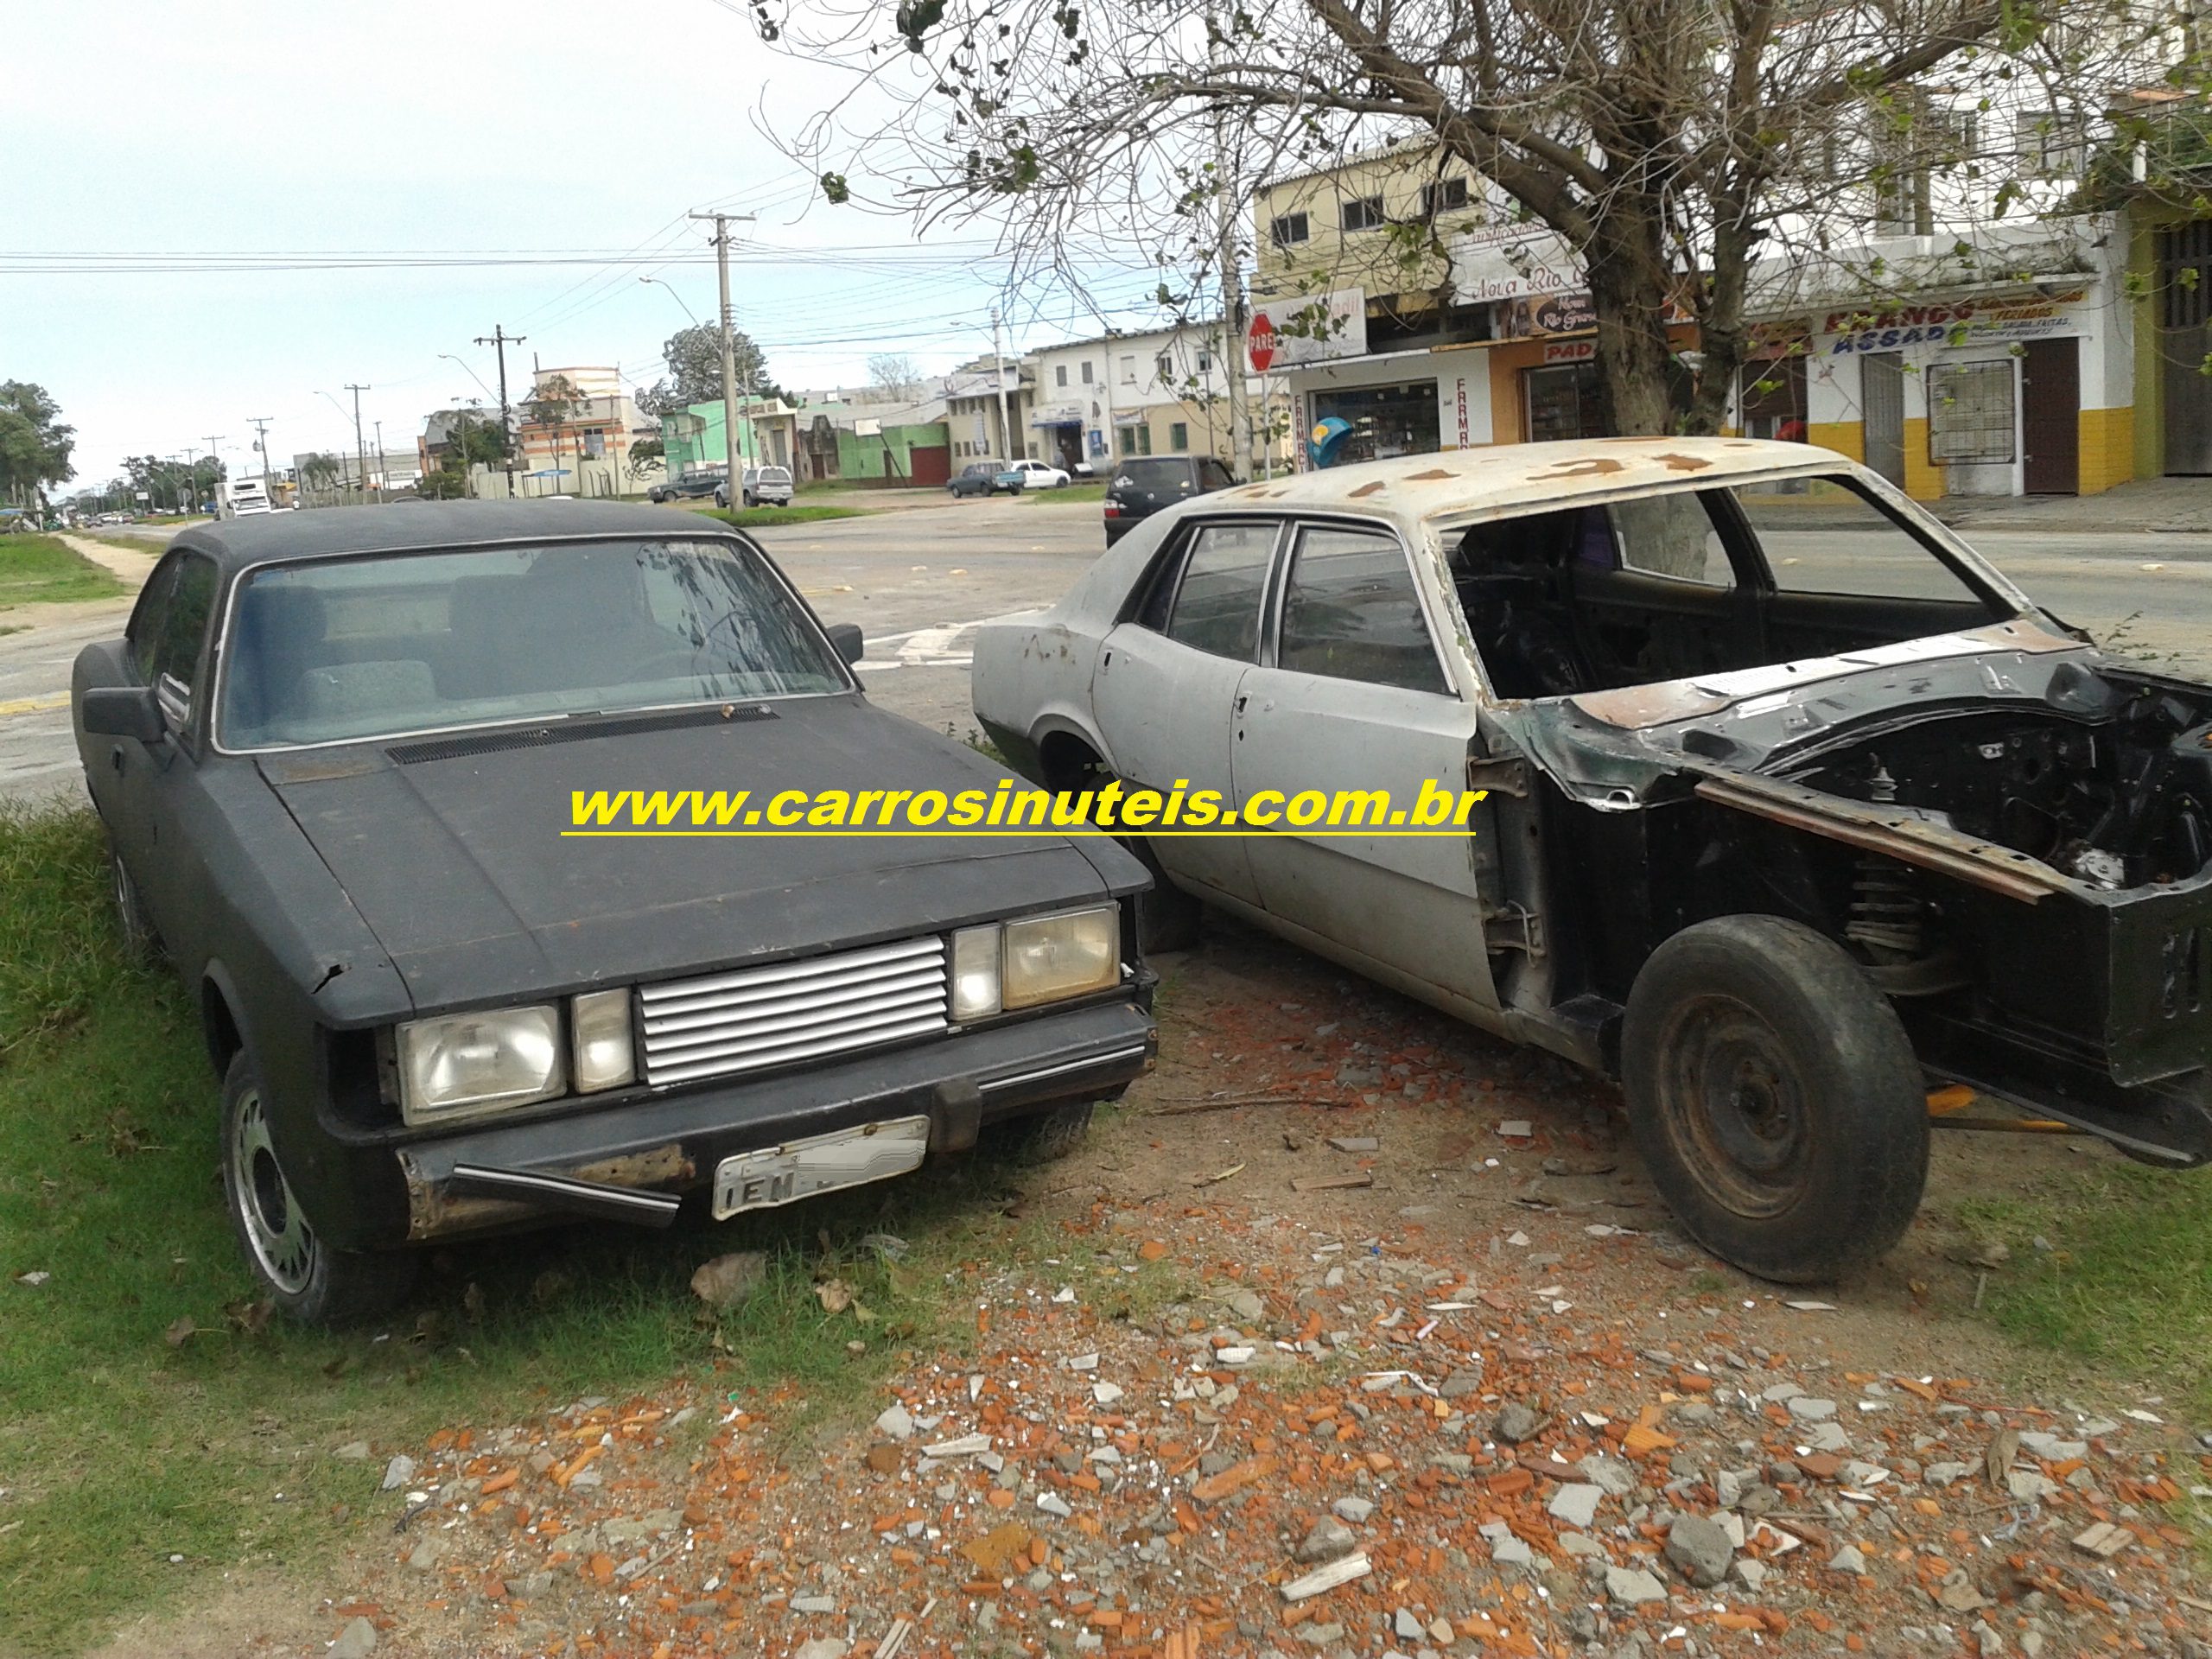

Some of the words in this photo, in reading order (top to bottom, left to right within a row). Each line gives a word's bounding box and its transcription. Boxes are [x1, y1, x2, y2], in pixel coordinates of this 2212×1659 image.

[1473, 278, 1517, 299] Nova
[1526, 267, 1561, 291] Rio
[1249, 332, 1275, 353] PARE
[1547, 342, 1596, 361] PAD
[1294, 394, 1306, 474] FARMACI
